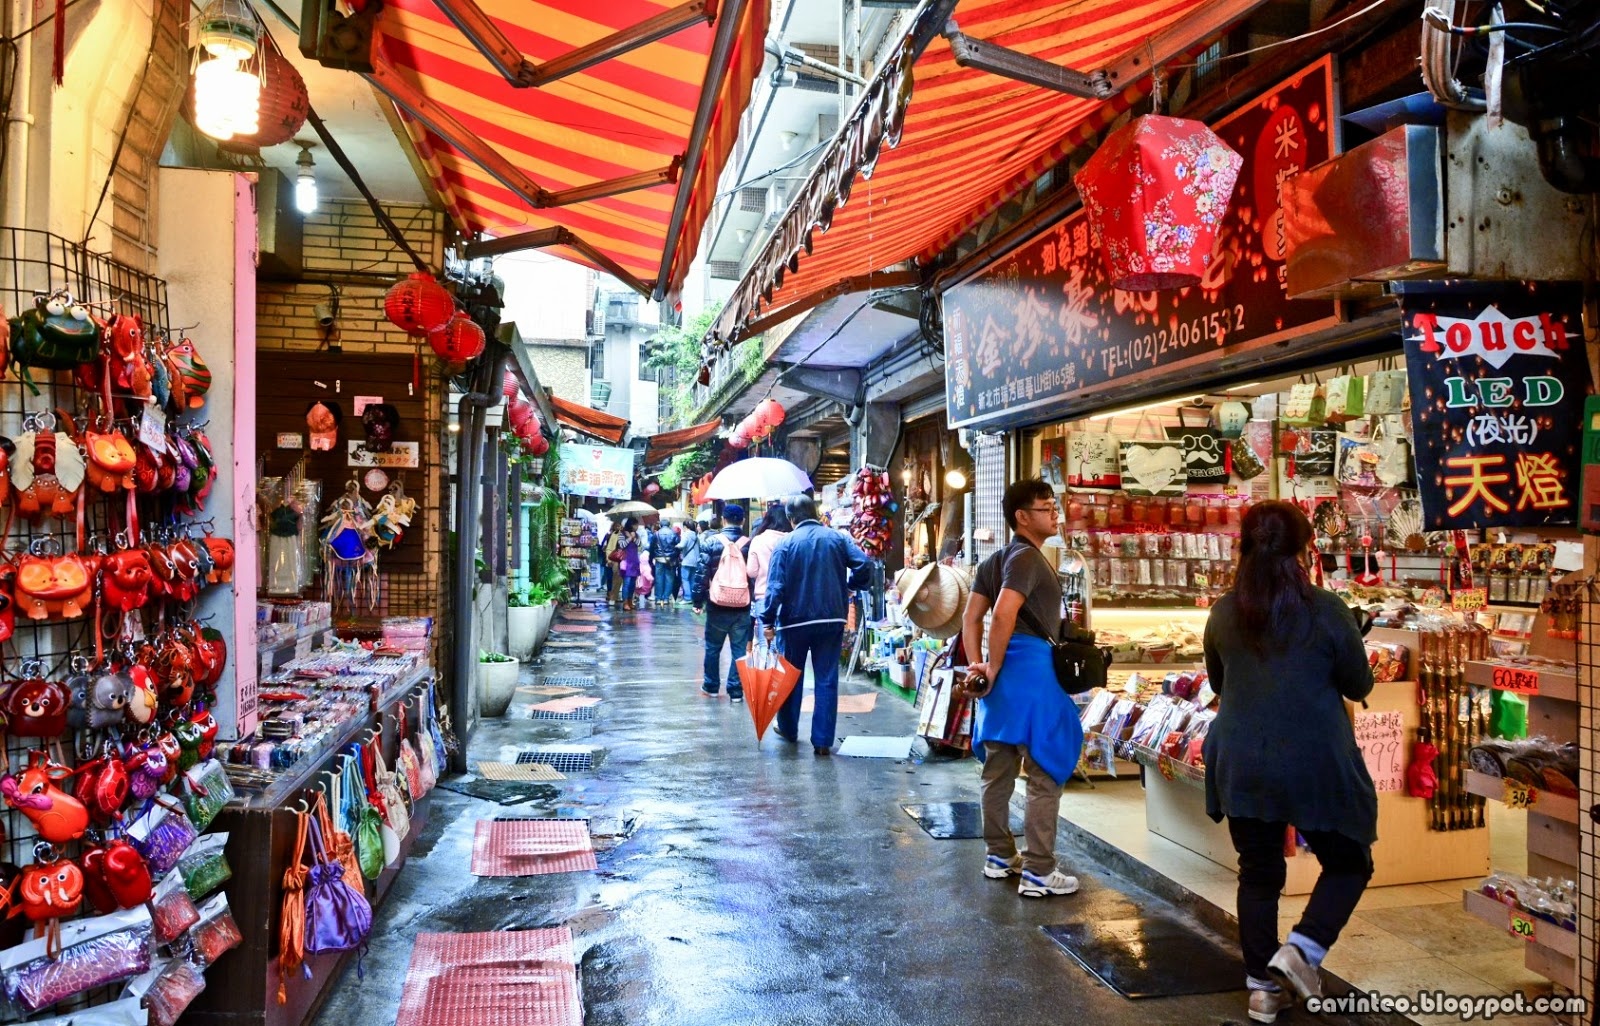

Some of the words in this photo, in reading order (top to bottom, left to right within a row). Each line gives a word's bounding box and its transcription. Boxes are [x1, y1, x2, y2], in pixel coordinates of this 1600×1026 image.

[1413, 312, 1569, 352] Touch
[1444, 376, 1564, 408] LED
[1466, 413, 1538, 447] (夜光)
[1444, 453, 1571, 517] 天燈
